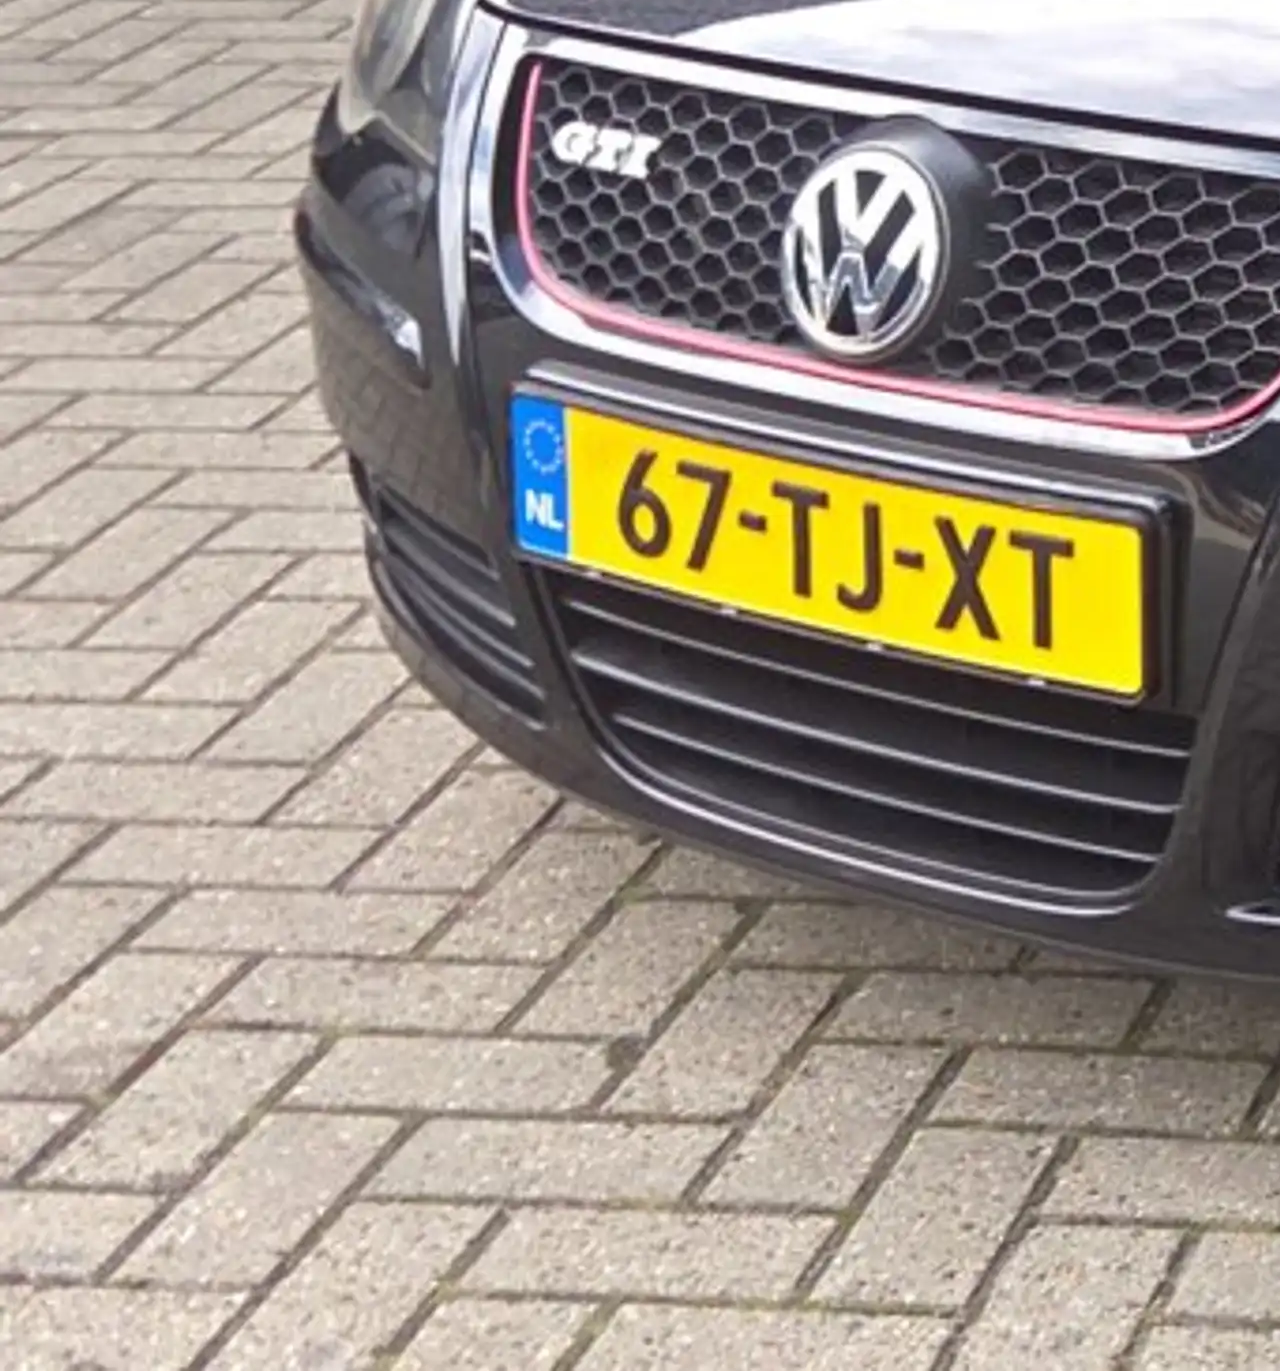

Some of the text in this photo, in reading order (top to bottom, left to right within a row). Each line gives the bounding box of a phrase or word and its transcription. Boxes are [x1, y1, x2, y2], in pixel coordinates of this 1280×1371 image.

[551, 120, 662, 179] GTI
[787, 149, 942, 355] VW
[525, 490, 563, 532] NL
[617, 449, 1076, 650] 67-TJ-XT
